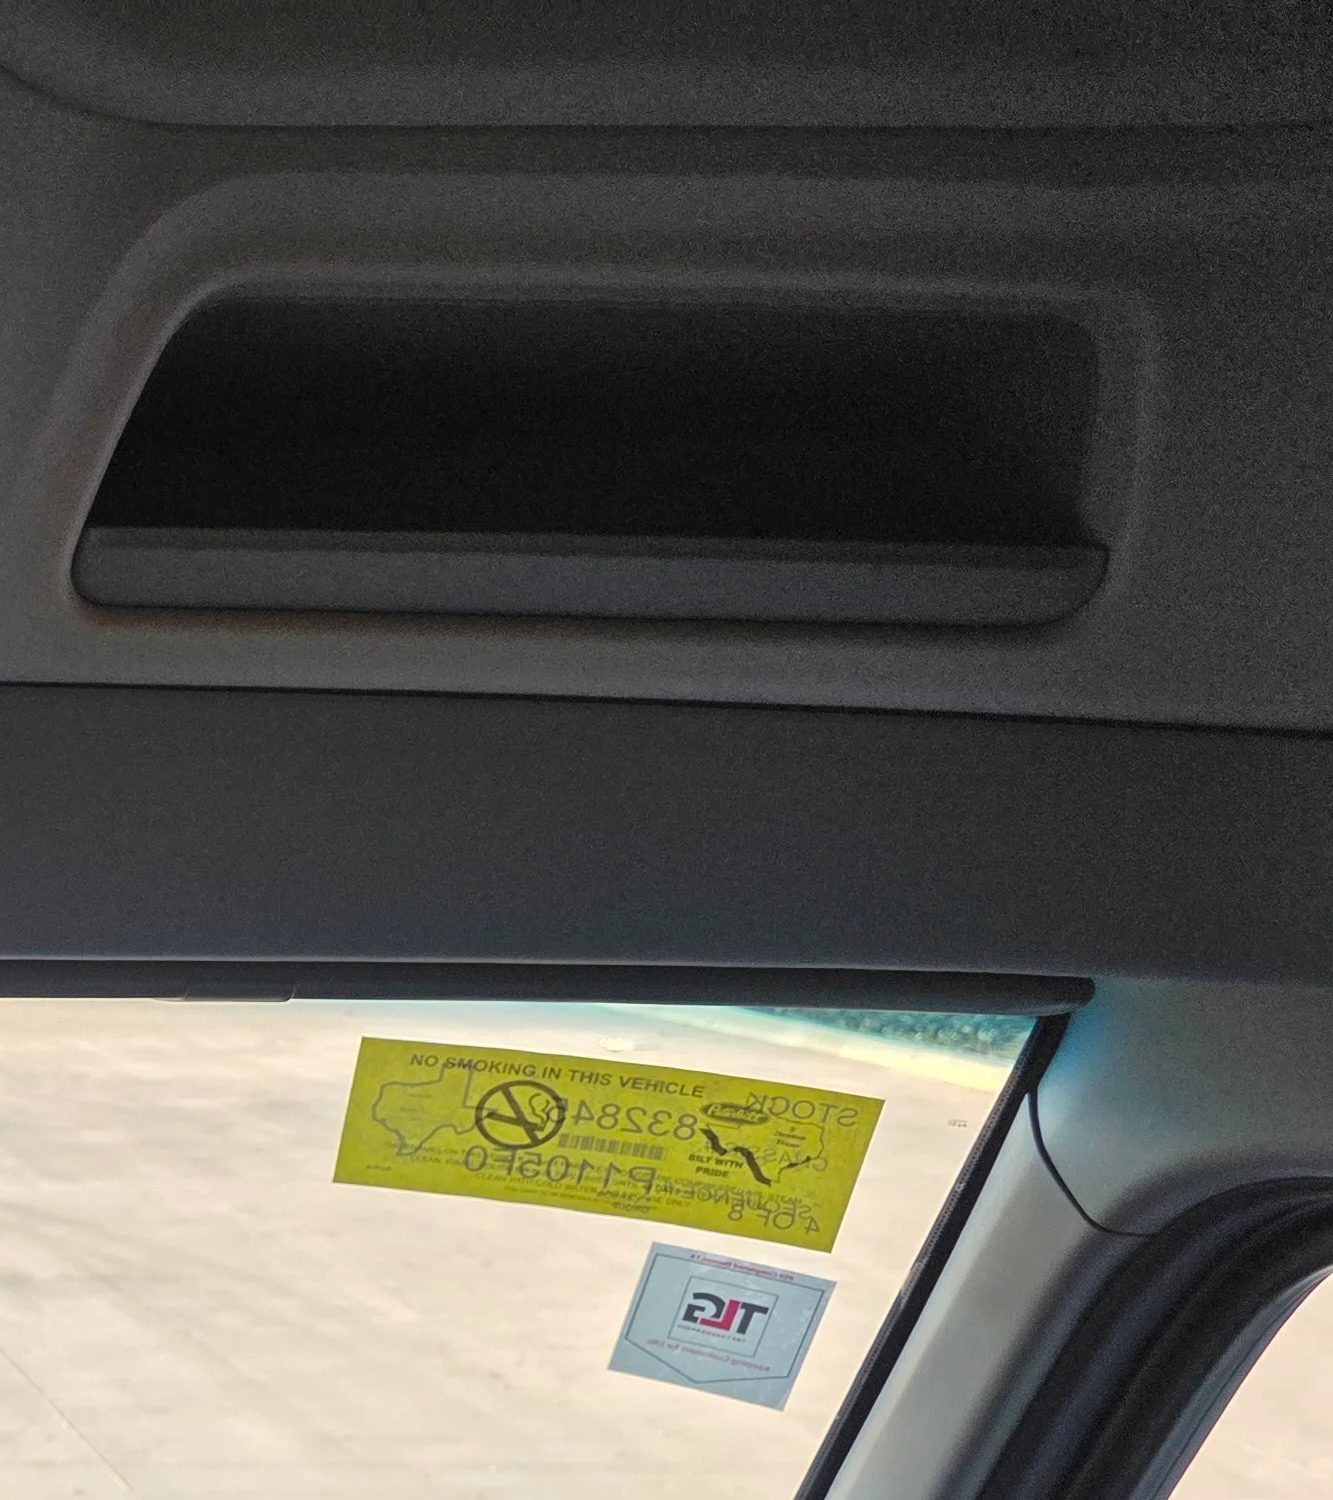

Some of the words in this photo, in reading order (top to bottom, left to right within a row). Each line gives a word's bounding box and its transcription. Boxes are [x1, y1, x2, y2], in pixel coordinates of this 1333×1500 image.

[409, 1054, 439, 1068] NO
[444, 1057, 537, 1077] SMOKING
[542, 1066, 563, 1080] IN
[568, 1069, 613, 1087] THIS
[618, 1075, 706, 1098] VEHICLE
[688, 1153, 712, 1164] BILT
[715, 1157, 744, 1170] WITH
[695, 1166, 729, 1178] PRIDE
